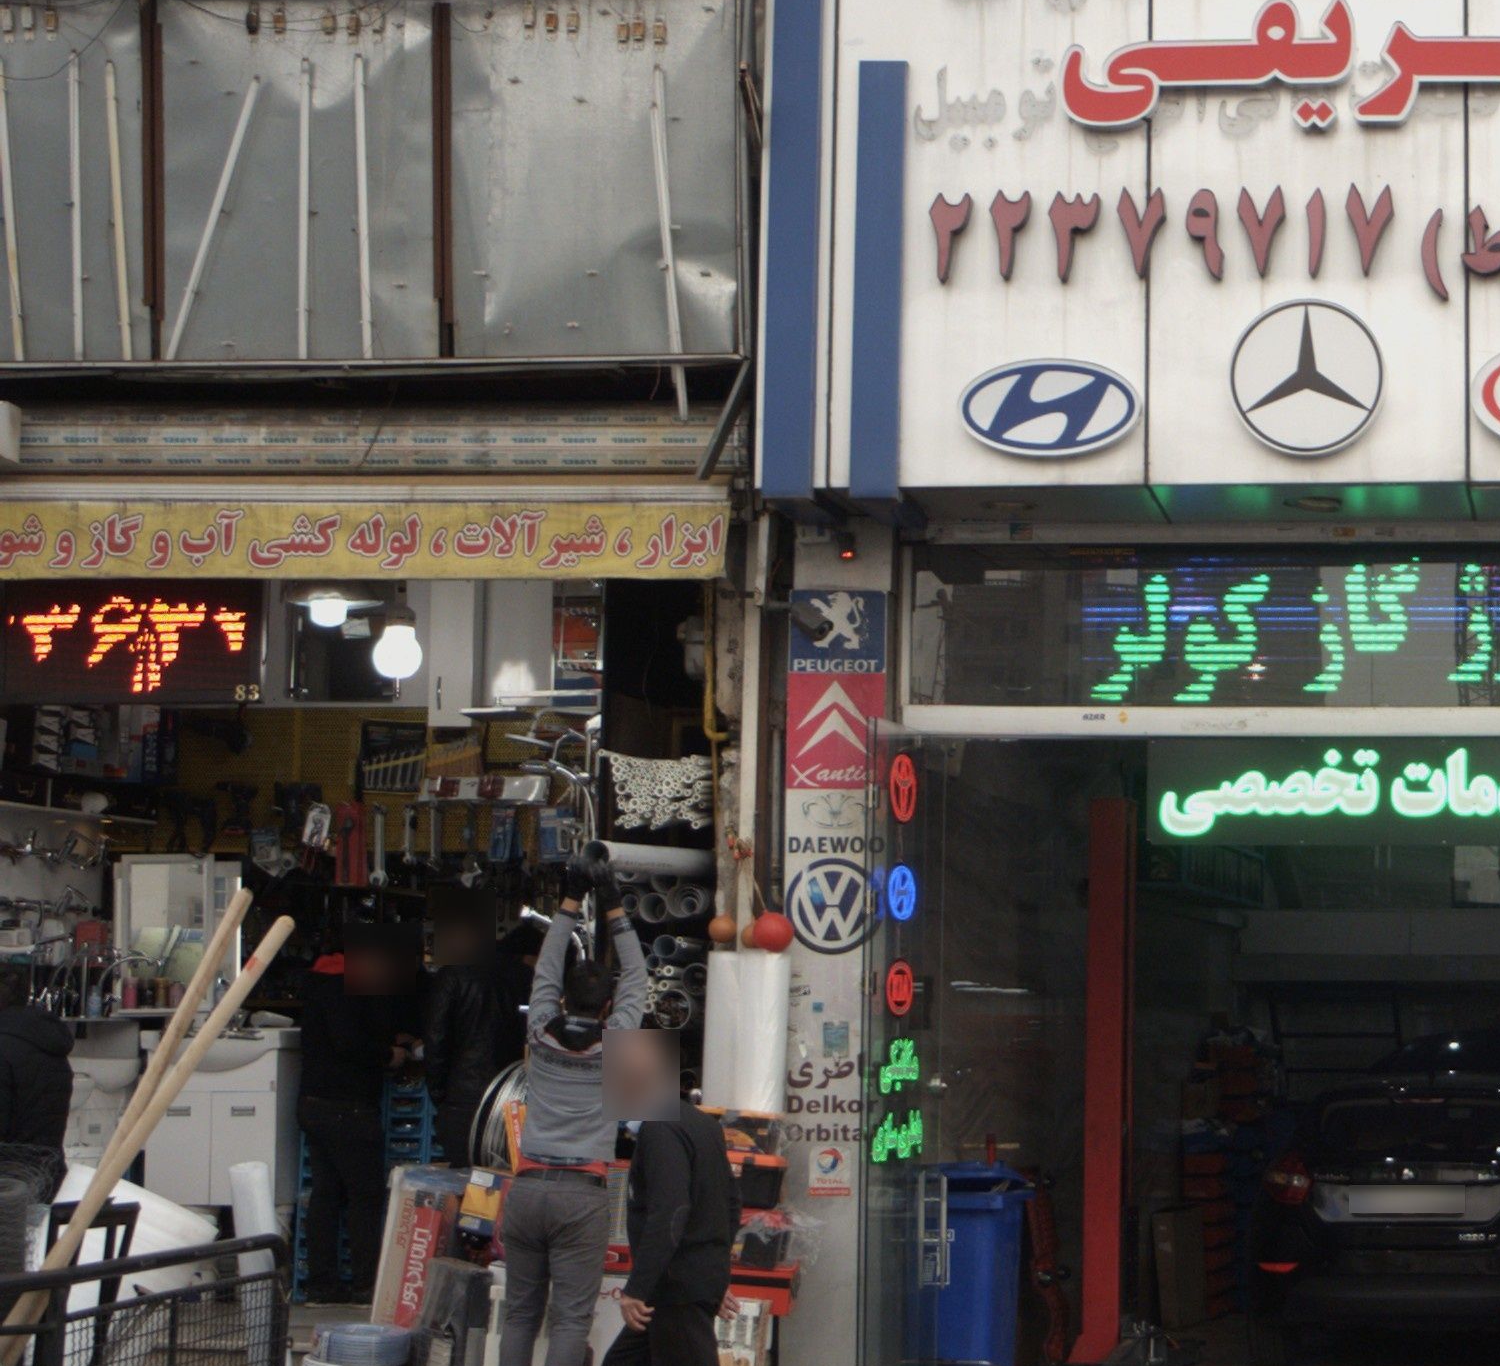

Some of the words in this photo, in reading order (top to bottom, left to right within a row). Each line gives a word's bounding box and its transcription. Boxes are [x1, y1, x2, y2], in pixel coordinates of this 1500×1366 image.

[927, 181, 1396, 285] ۲۲۳۷۹۷۱۷
[50, 528, 78, 569] و
[83, 513, 147, 569] گاز
[145, 528, 172, 569] و
[177, 508, 246, 567] آب
[248, 512, 342, 569] کشی
[347, 512, 422, 567] لوله
[453, 509, 546, 558] آلات
[540, 514, 608, 569] شیر
[634, 512, 725, 569] ابزار
[1090, 573, 1273, 703] کولر
[1303, 556, 1422, 693] گاز
[234, 684, 261, 701] 83
[793, 658, 879, 673] PEUGEOT
[1158, 748, 1380, 839] تخصصی
[788, 835, 885, 854] DAEWOO
[787, 1094, 879, 1114] Delkor
[785, 1123, 868, 1142] Orbita
